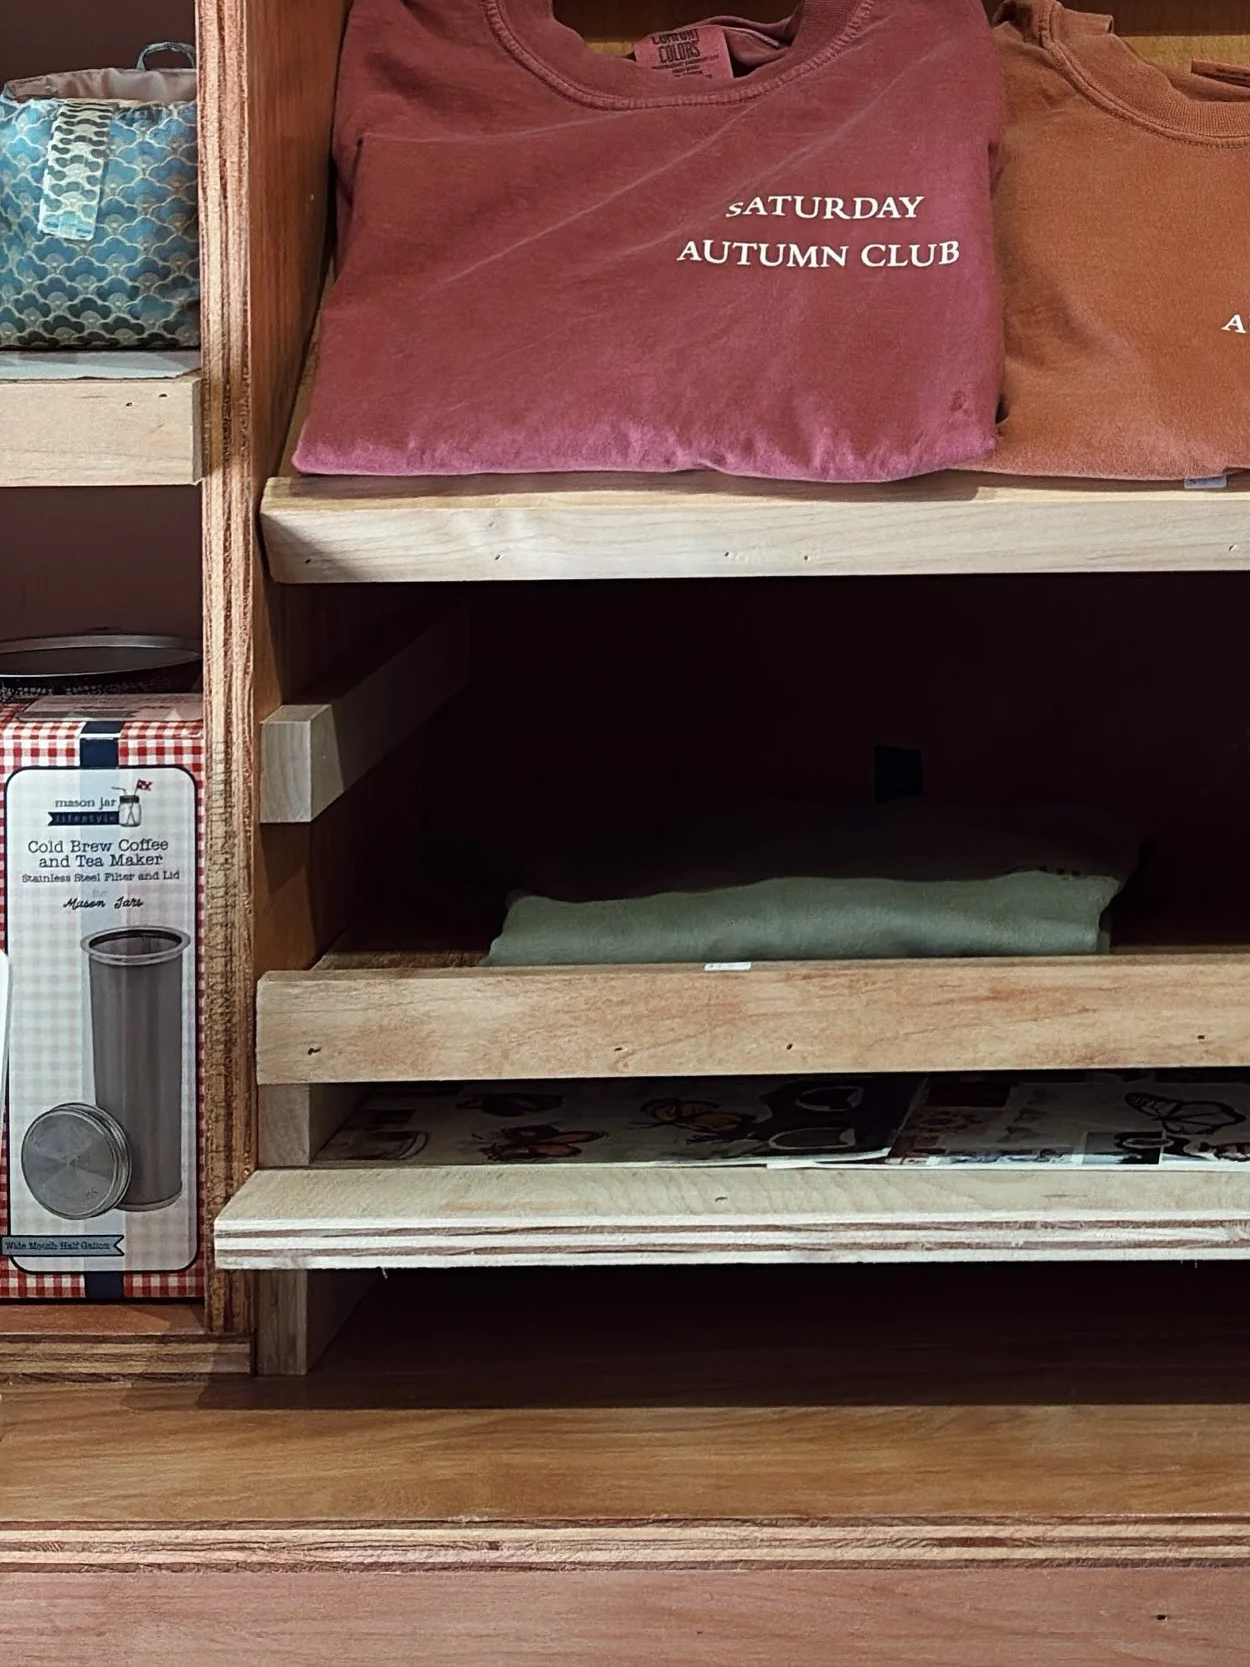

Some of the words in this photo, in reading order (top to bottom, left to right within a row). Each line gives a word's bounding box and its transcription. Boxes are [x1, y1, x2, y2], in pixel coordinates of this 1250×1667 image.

[725, 195, 925, 220] SATURDAY
[676, 239, 850, 268] AUTUMN
[860, 240, 960, 268] CLUB
[54, 798, 96, 808] mason
[98, 797, 117, 810] jar
[27, 840, 64, 853] Cold
[70, 841, 113, 853] Brew
[118, 838, 169, 852] Coffee
[39, 854, 70, 868] and
[75, 854, 105, 868] Tea
[110, 853, 164, 867] Maker
[21, 873, 72, 883] Stainless
[74, 873, 101, 883] Steel
[103, 872, 135, 882] Filter
[138, 871, 160, 881] and
[162, 870, 180, 880] Lid
[63, 896, 106, 911] Mason
[113, 896, 144, 910] Jars
[5, 1241, 27, 1250] Wide
[29, 1241, 58, 1251] Mouth
[60, 1241, 80, 1250] Half
[81, 1241, 110, 1250] Gallon
